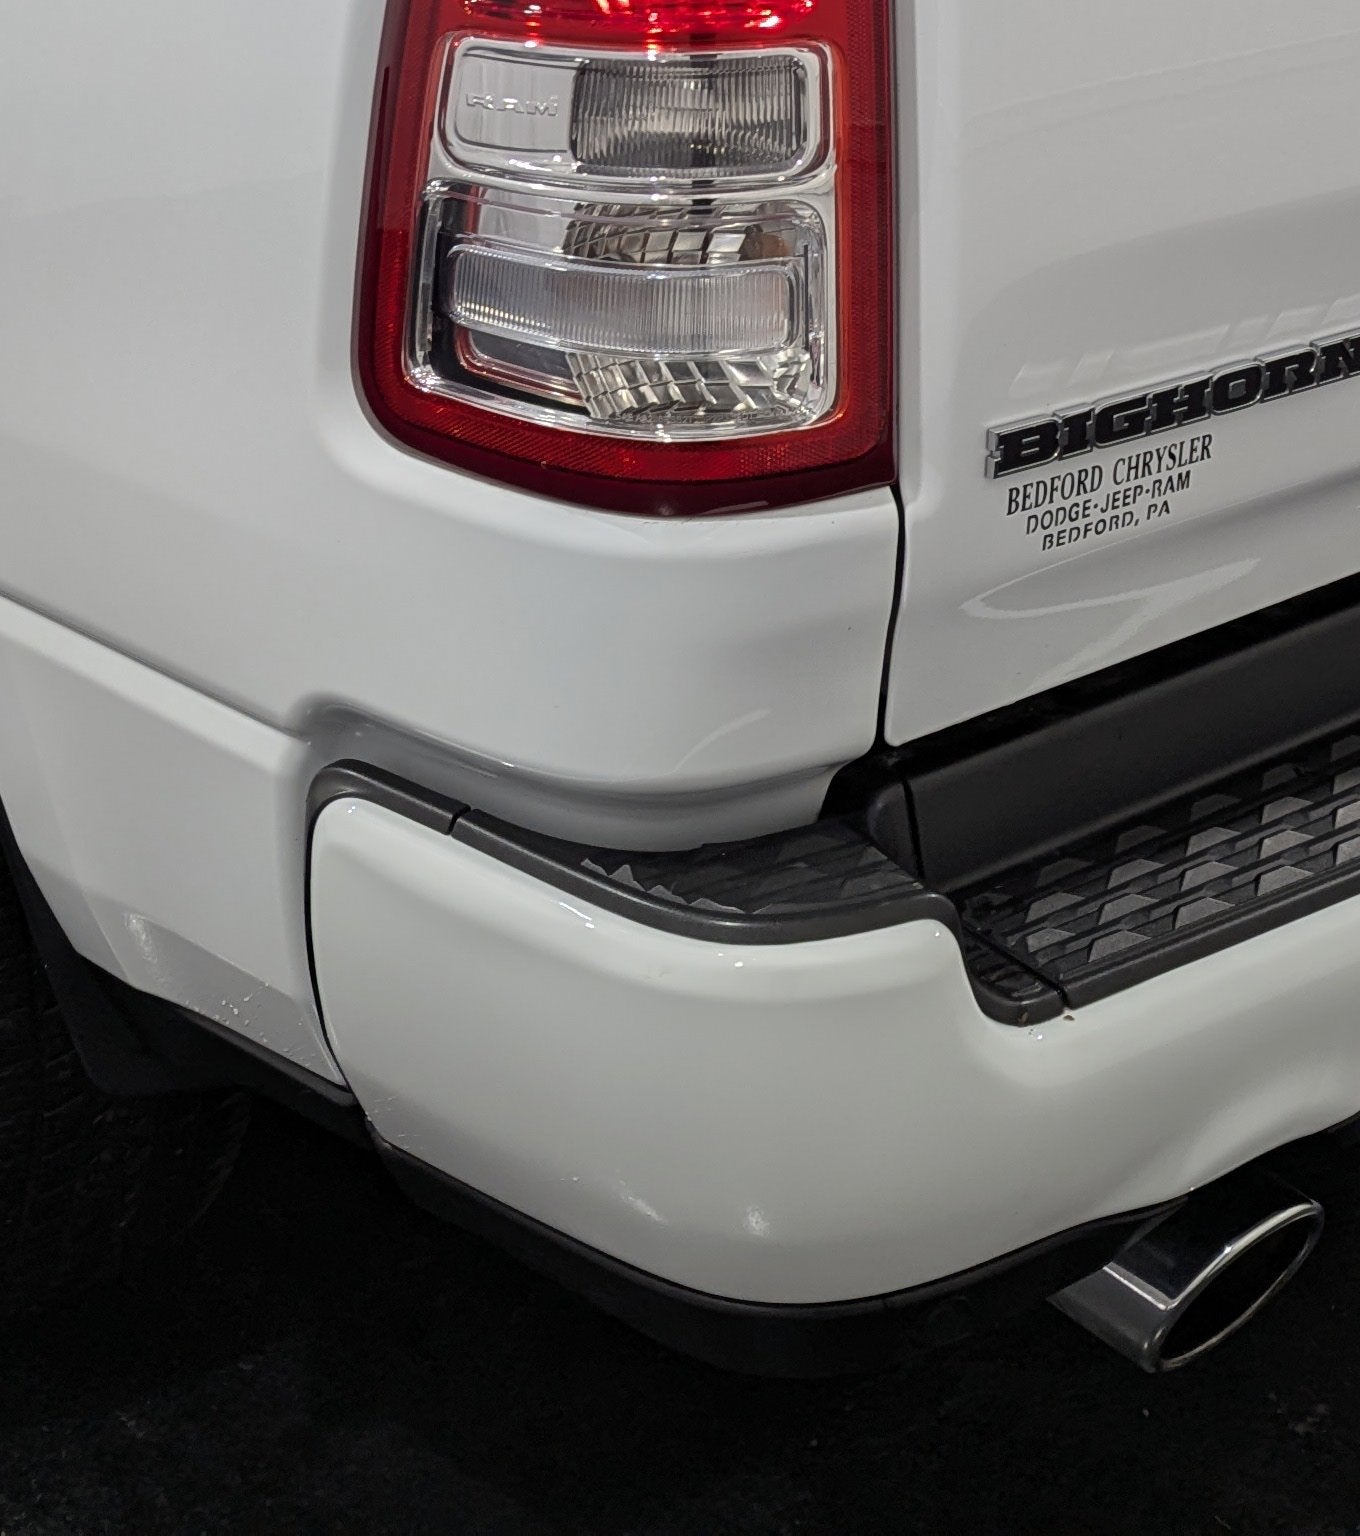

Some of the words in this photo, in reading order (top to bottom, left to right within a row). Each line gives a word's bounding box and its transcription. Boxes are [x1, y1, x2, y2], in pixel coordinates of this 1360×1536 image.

[1006, 464, 1103, 517] BEDFORD
[1113, 433, 1214, 487] CHRYSLER
[1042, 510, 1139, 552] BEDFORD,
[1147, 501, 1171, 521] PA
